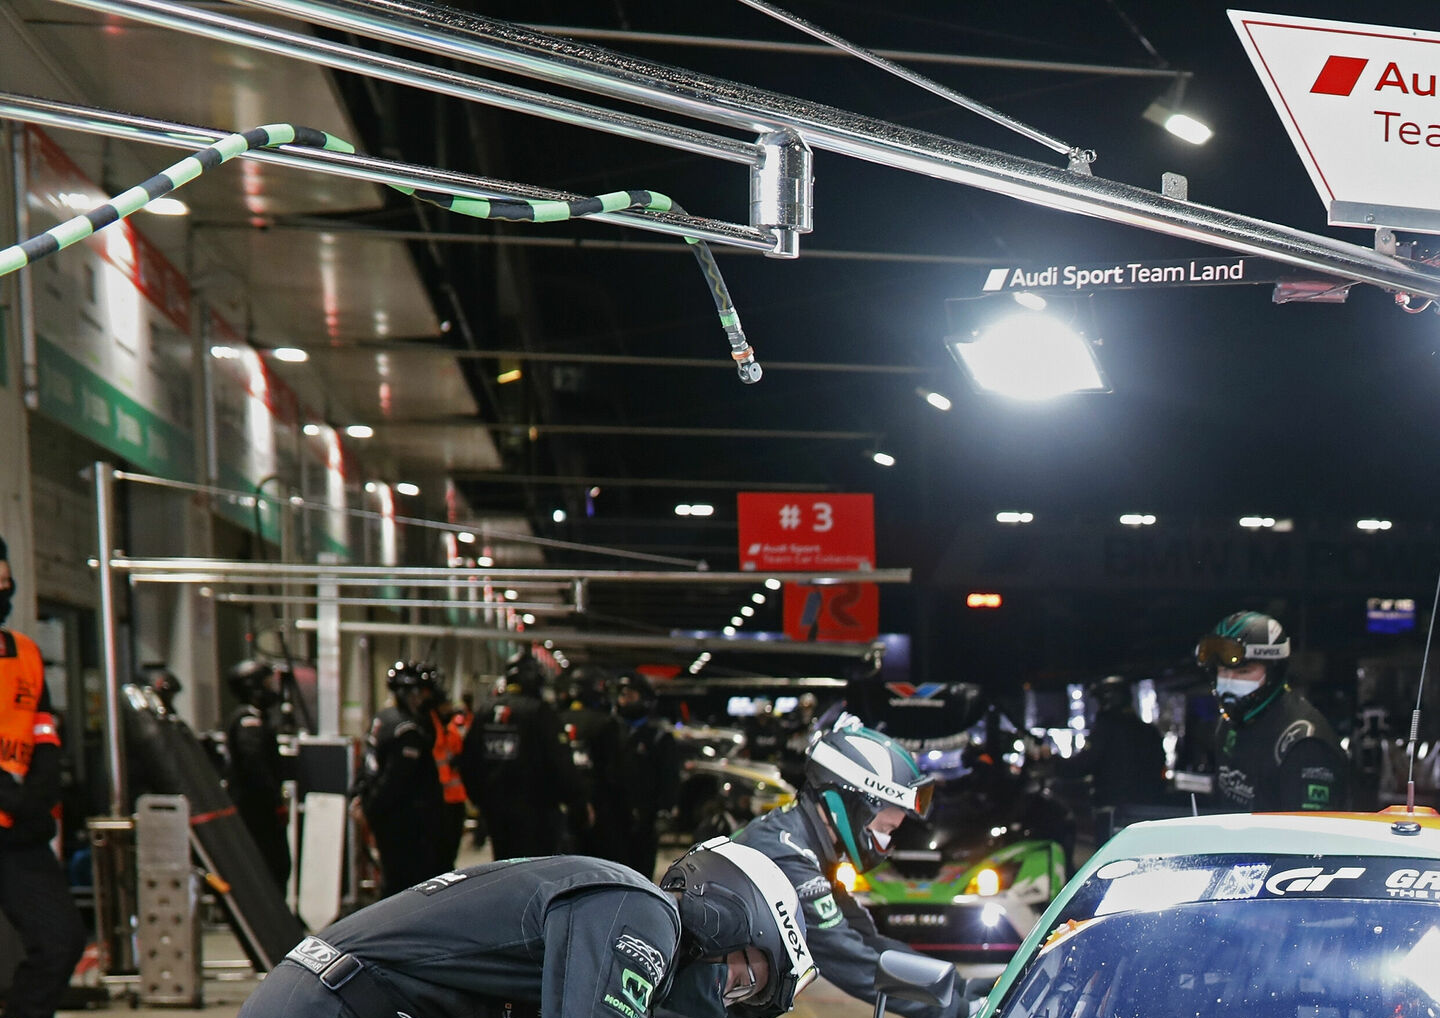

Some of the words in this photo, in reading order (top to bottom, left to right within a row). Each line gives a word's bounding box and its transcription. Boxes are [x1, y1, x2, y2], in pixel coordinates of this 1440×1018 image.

[1009, 266, 1058, 288] Audi
[1062, 264, 1124, 290] Sport
[1126, 262, 1186, 284] Team
[1188, 259, 1244, 281] Land
[811, 502, 834, 533] 3
[864, 776, 906, 800] uvex
[1386, 888, 1429, 900] THE
[775, 900, 807, 961] uvex
